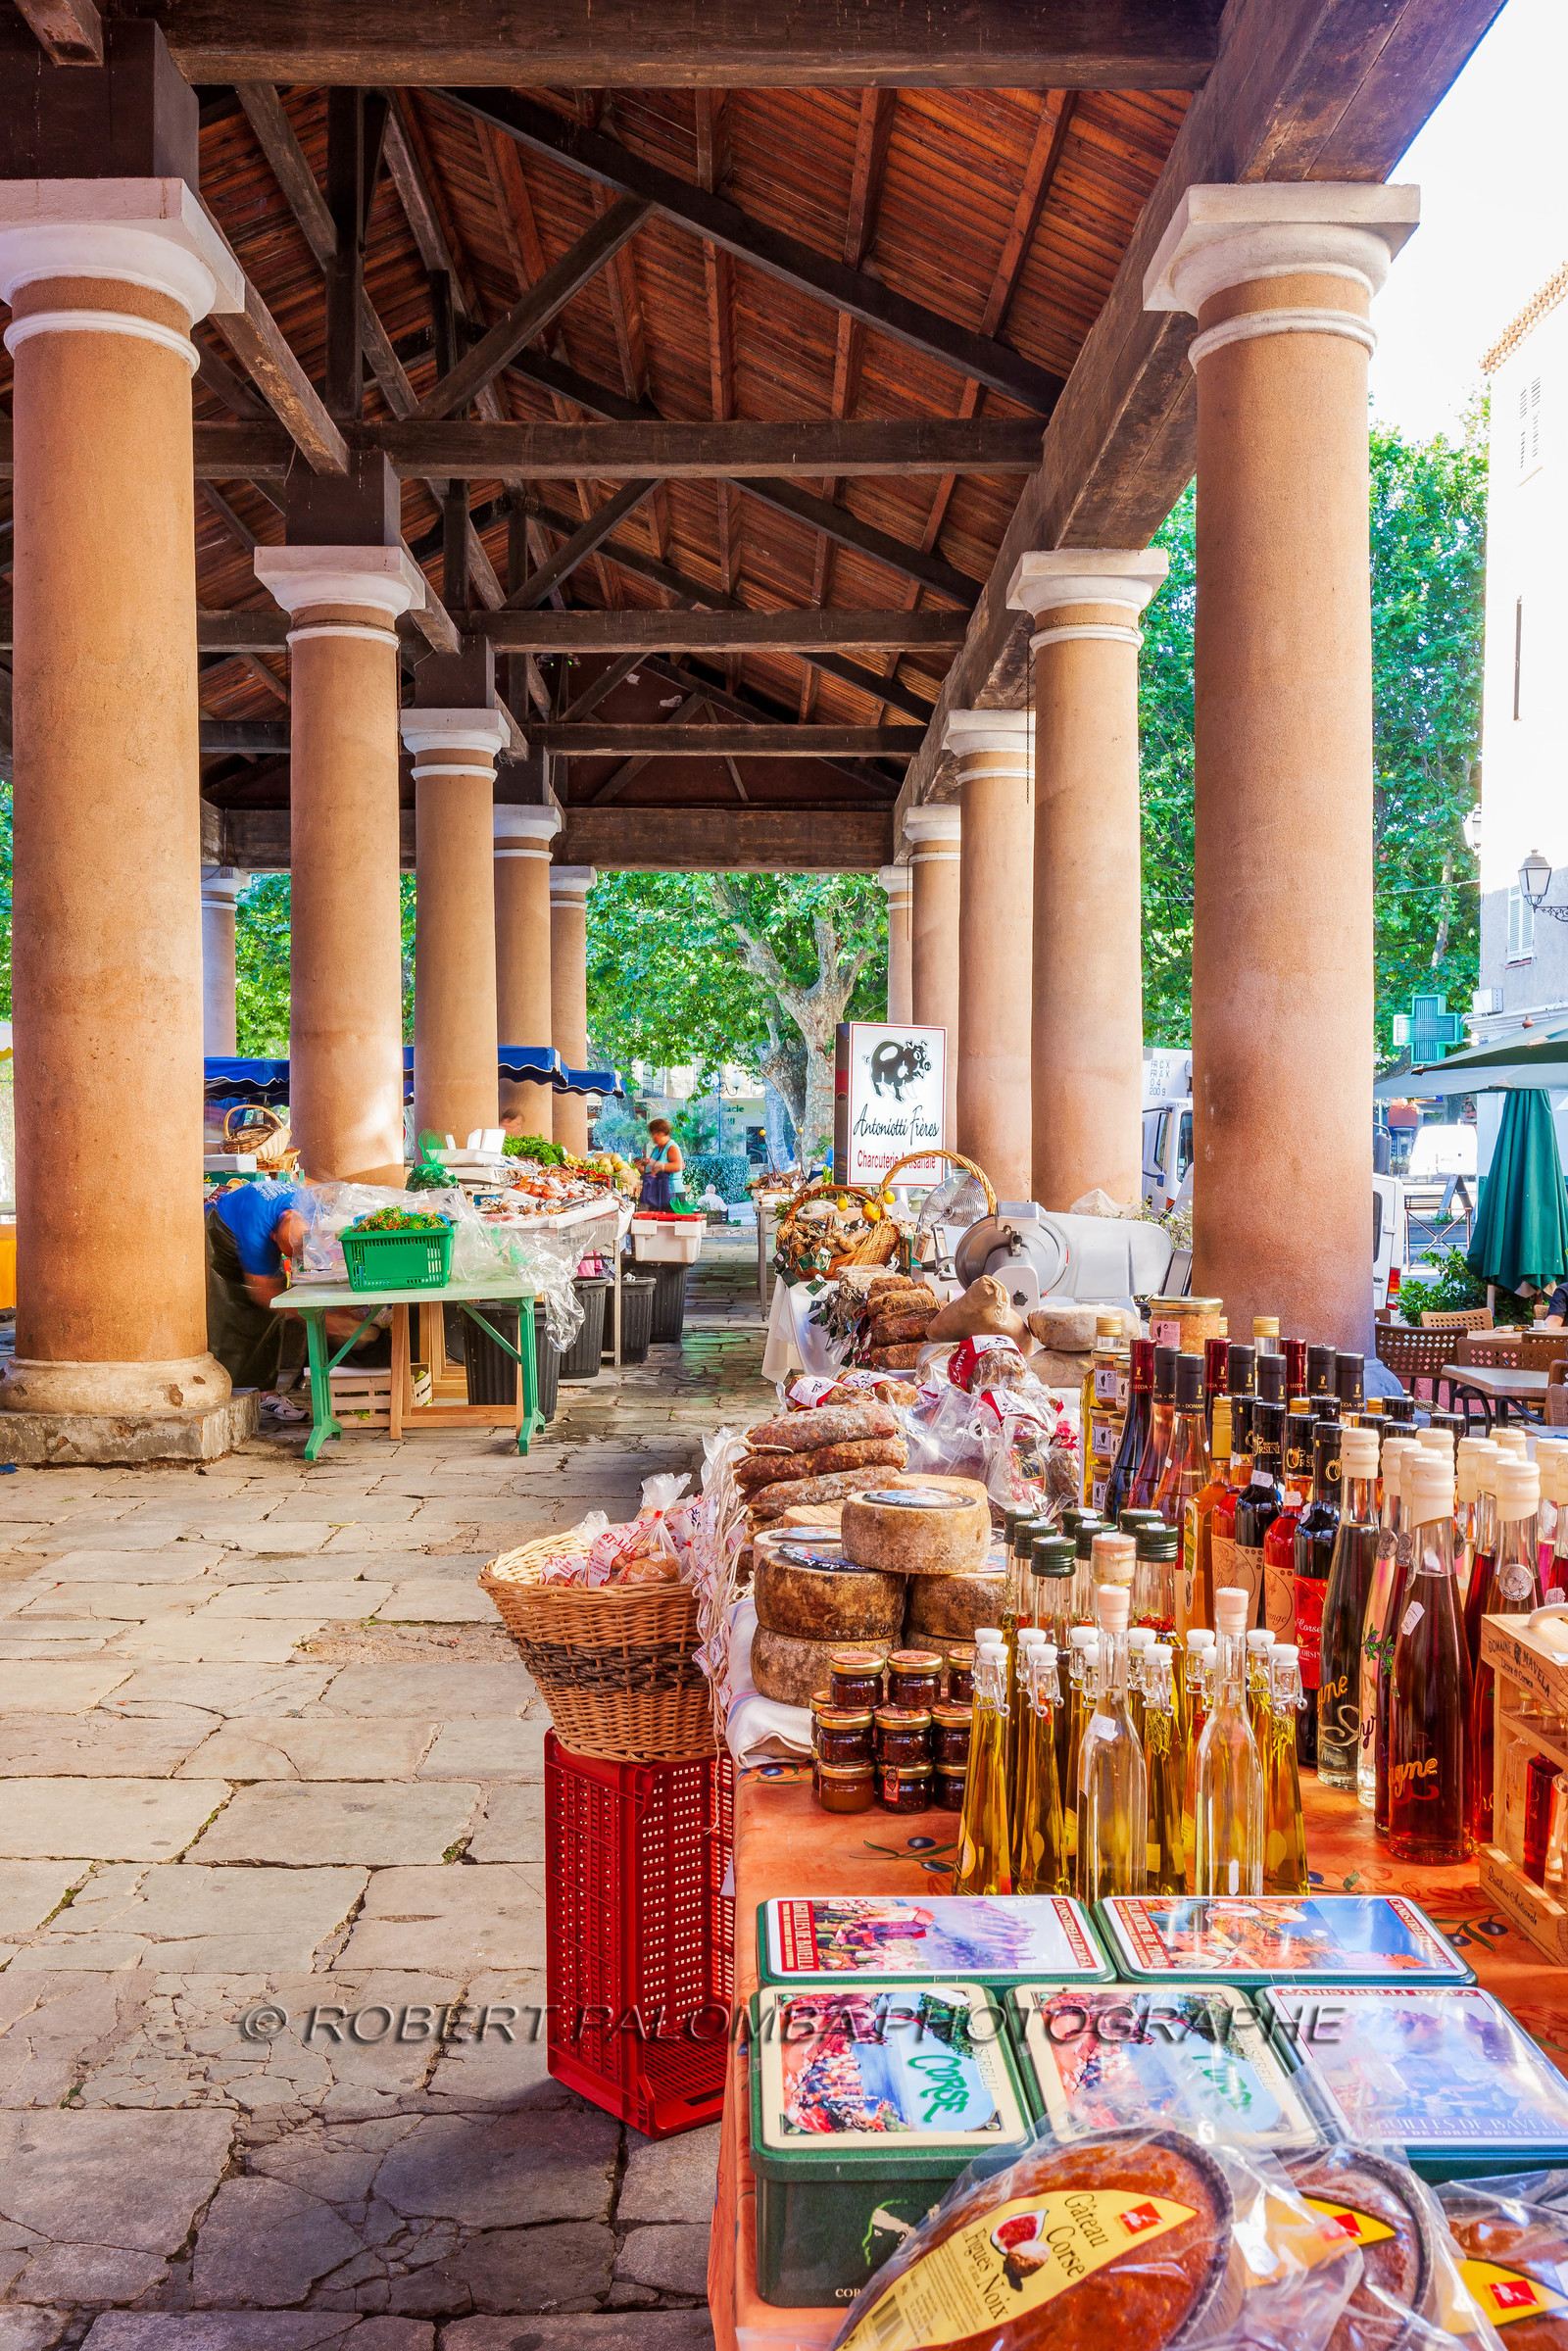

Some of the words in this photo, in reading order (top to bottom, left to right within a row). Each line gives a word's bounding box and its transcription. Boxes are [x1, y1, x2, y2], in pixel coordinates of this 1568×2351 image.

[853, 1103, 907, 1137] Antoniotti
[907, 1104, 941, 1147] Frères
[857, 1150, 900, 1169] Charcuterie
[900, 1151, 936, 1169] Atisanale
[1297, 1617, 1322, 1634] Corse
[1301, 1649, 1320, 1659] ORSIN
[1488, 1640, 1511, 1654] DOMAINE
[1523, 1649, 1550, 1698] MAVELA
[796, 1939, 814, 1971] BAVELLA
[907, 2054, 970, 2124] CORSE
[1491, 2119, 1565, 2130] BAVELL
[1064, 2193, 1108, 2248] Gâteau
[964, 2227, 994, 2272] Figues
[1046, 2226, 1086, 2278] Corse
[835, 2287, 862, 2298] COR
[976, 2273, 1010, 2320] Noix
